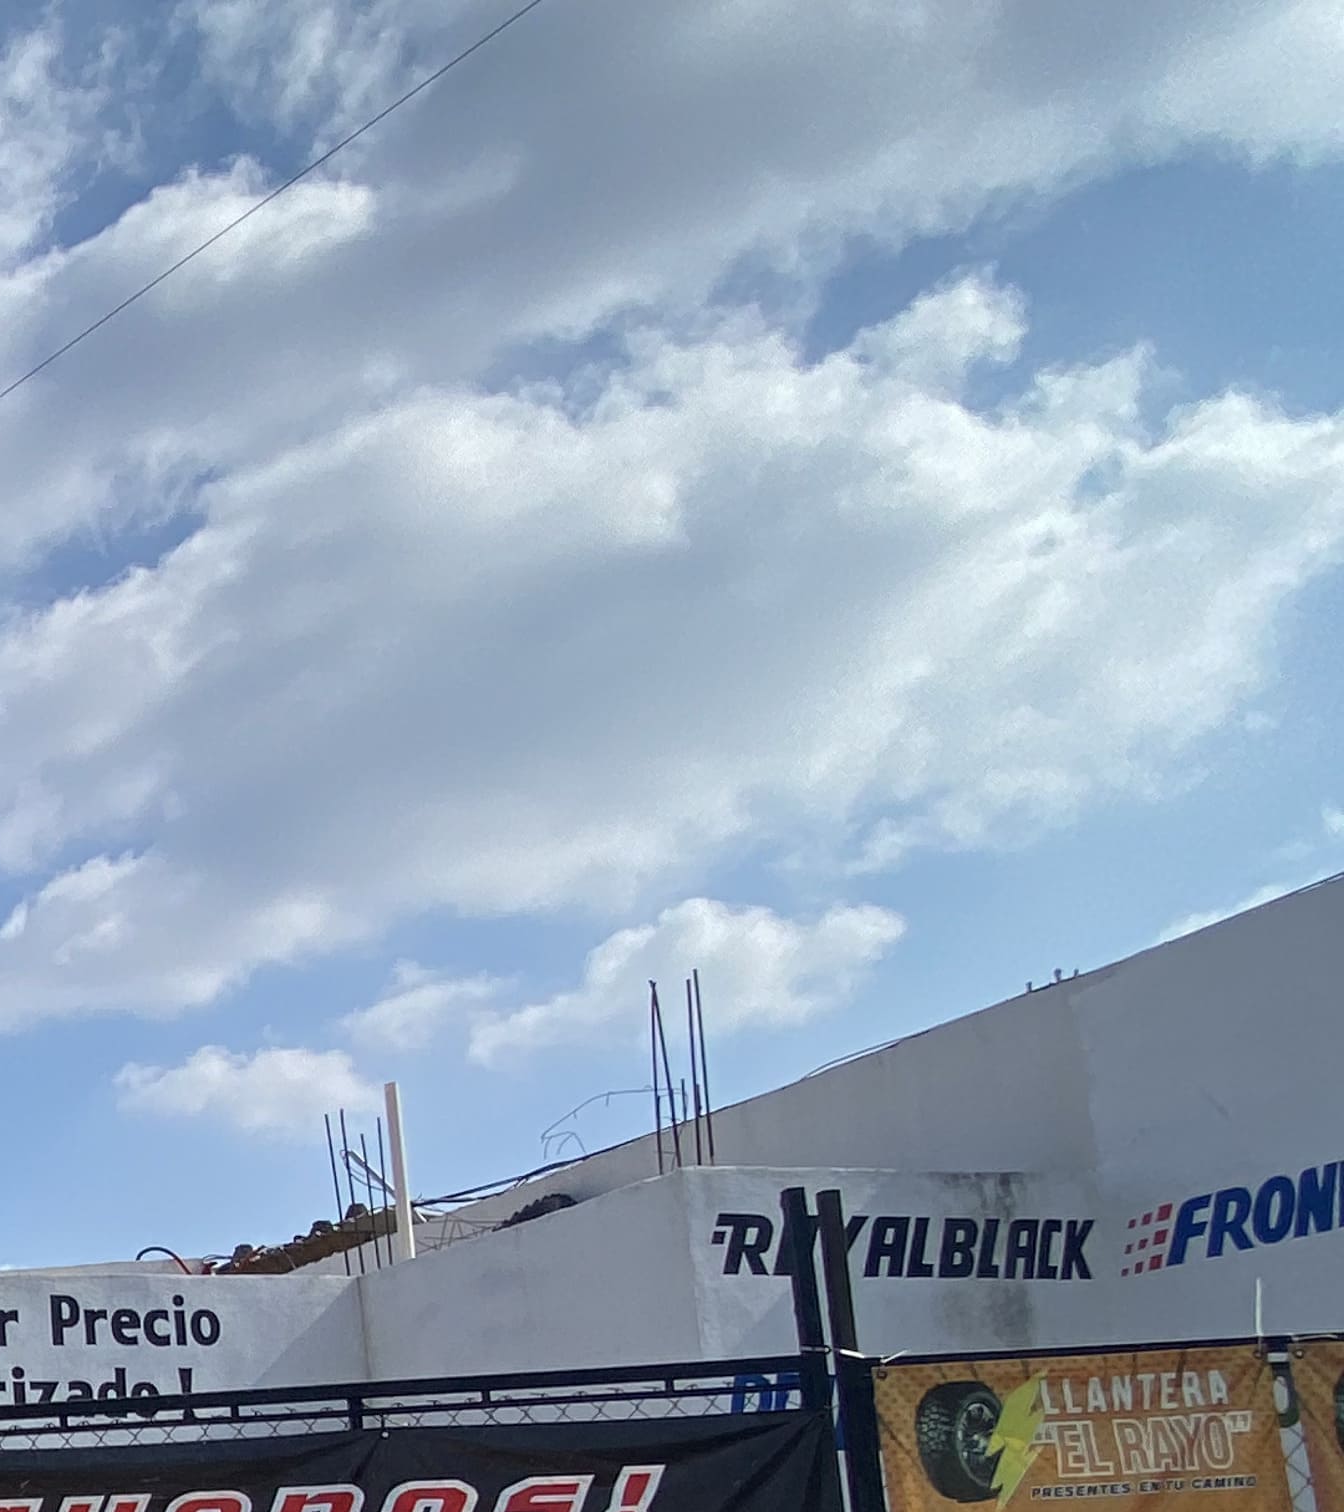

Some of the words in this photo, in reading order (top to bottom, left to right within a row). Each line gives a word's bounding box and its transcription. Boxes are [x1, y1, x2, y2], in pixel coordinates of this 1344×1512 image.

[1166, 1160, 1344, 1267] FRON
[711, 1211, 1096, 1281] RYALBLACK
[49, 1293, 222, 1348] Precio
[1037, 1369, 1231, 1417] LLANTERA
[1031, 1483, 1132, 1500] PRESENTES
[1137, 1480, 1162, 1495] EN
[1162, 1479, 1185, 1493] TU
[1191, 1474, 1258, 1490] CAMINO
